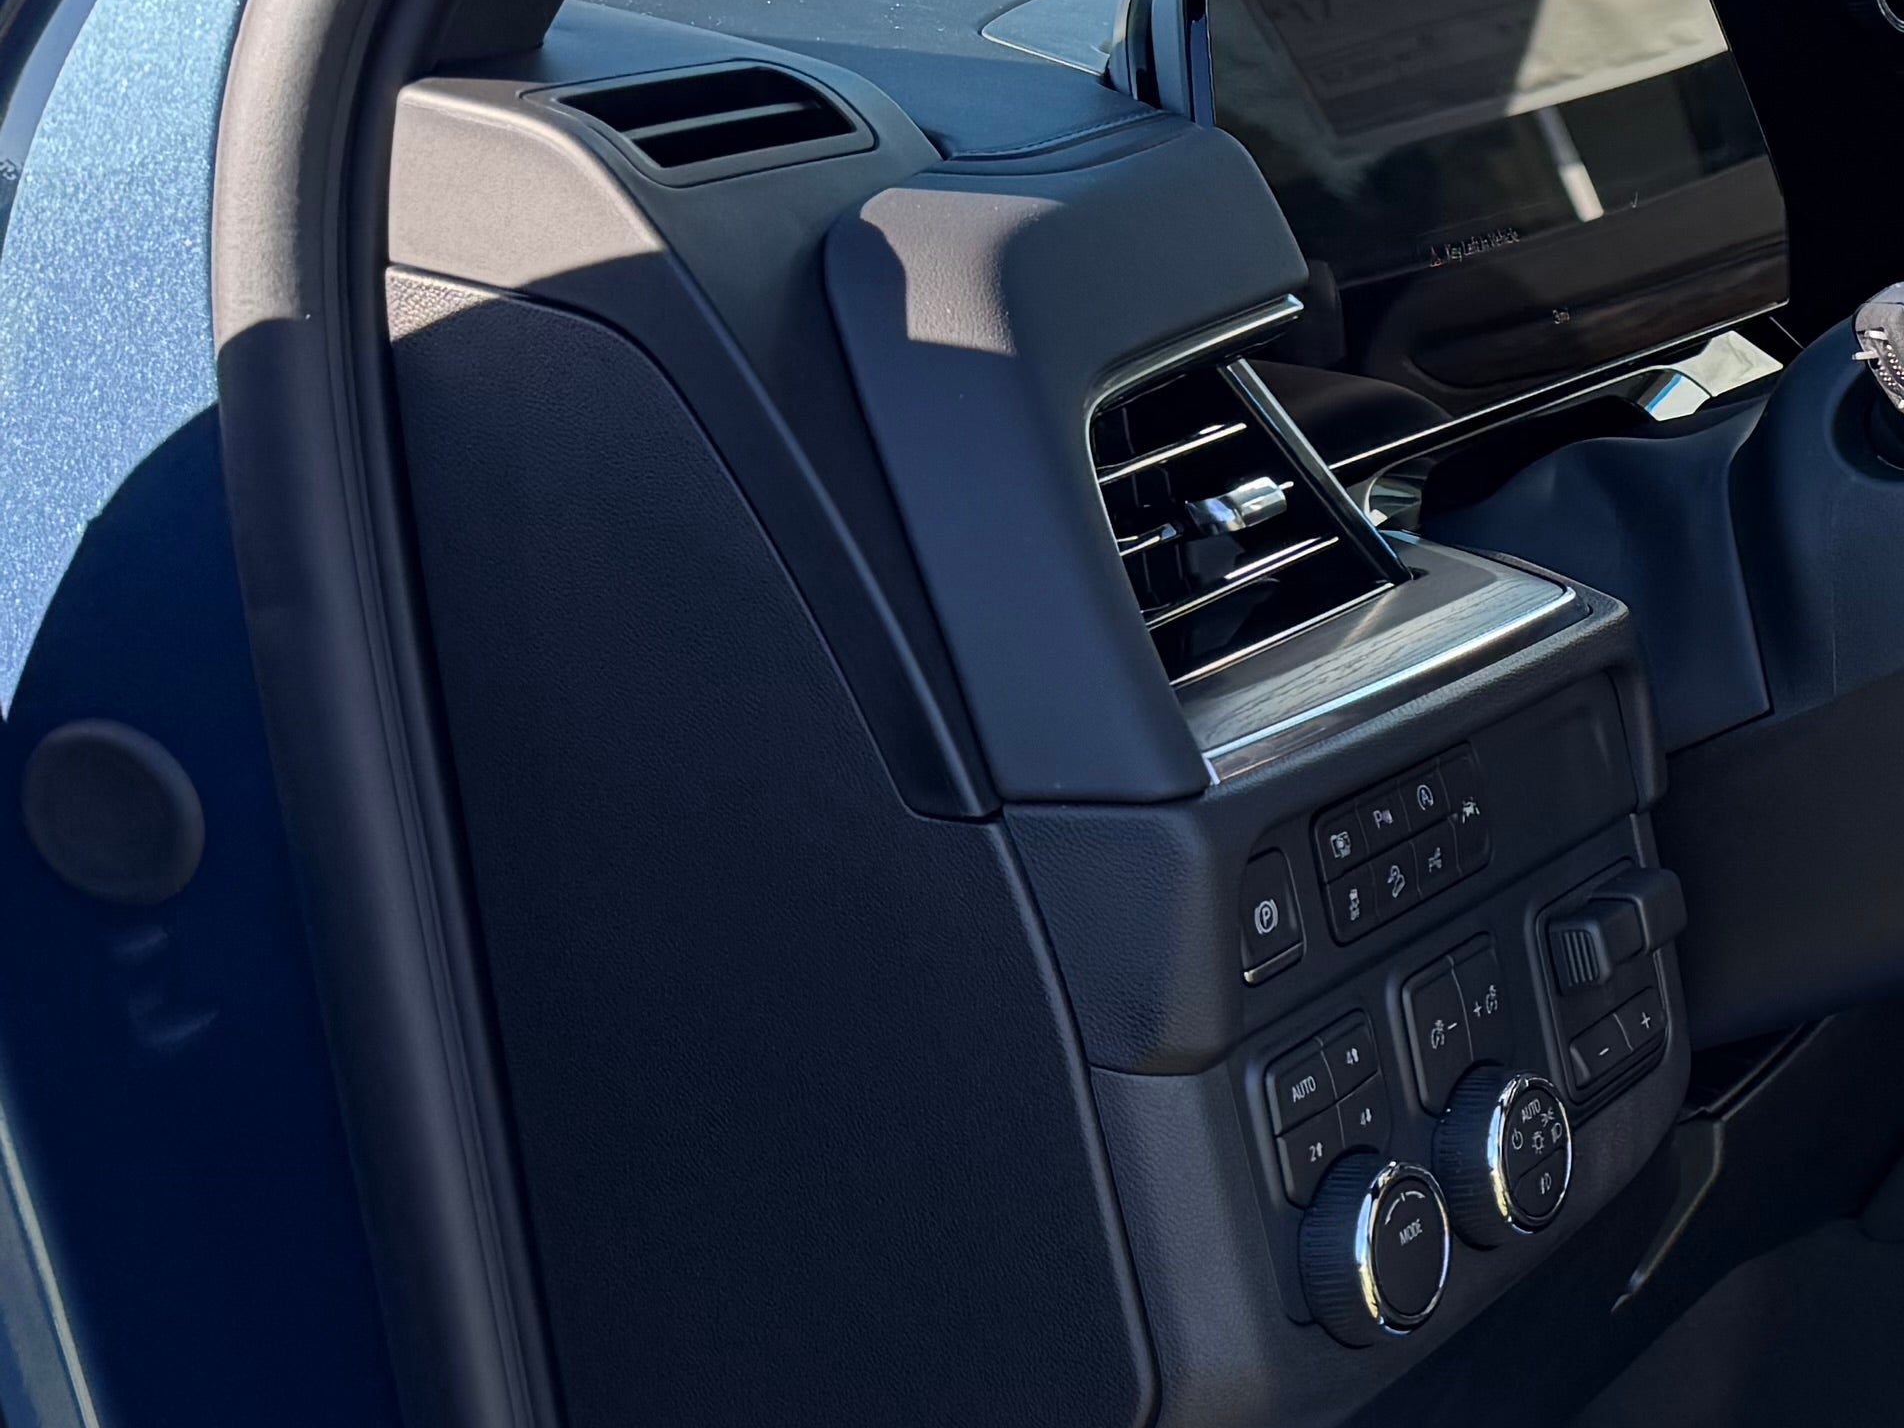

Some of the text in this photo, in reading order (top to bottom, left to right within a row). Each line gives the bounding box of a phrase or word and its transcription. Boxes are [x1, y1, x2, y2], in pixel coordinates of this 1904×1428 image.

[1291, 1076, 1317, 1103] AUTO
[1521, 1098, 1541, 1123] AUTO
[1399, 1218, 1423, 1247] MODE
